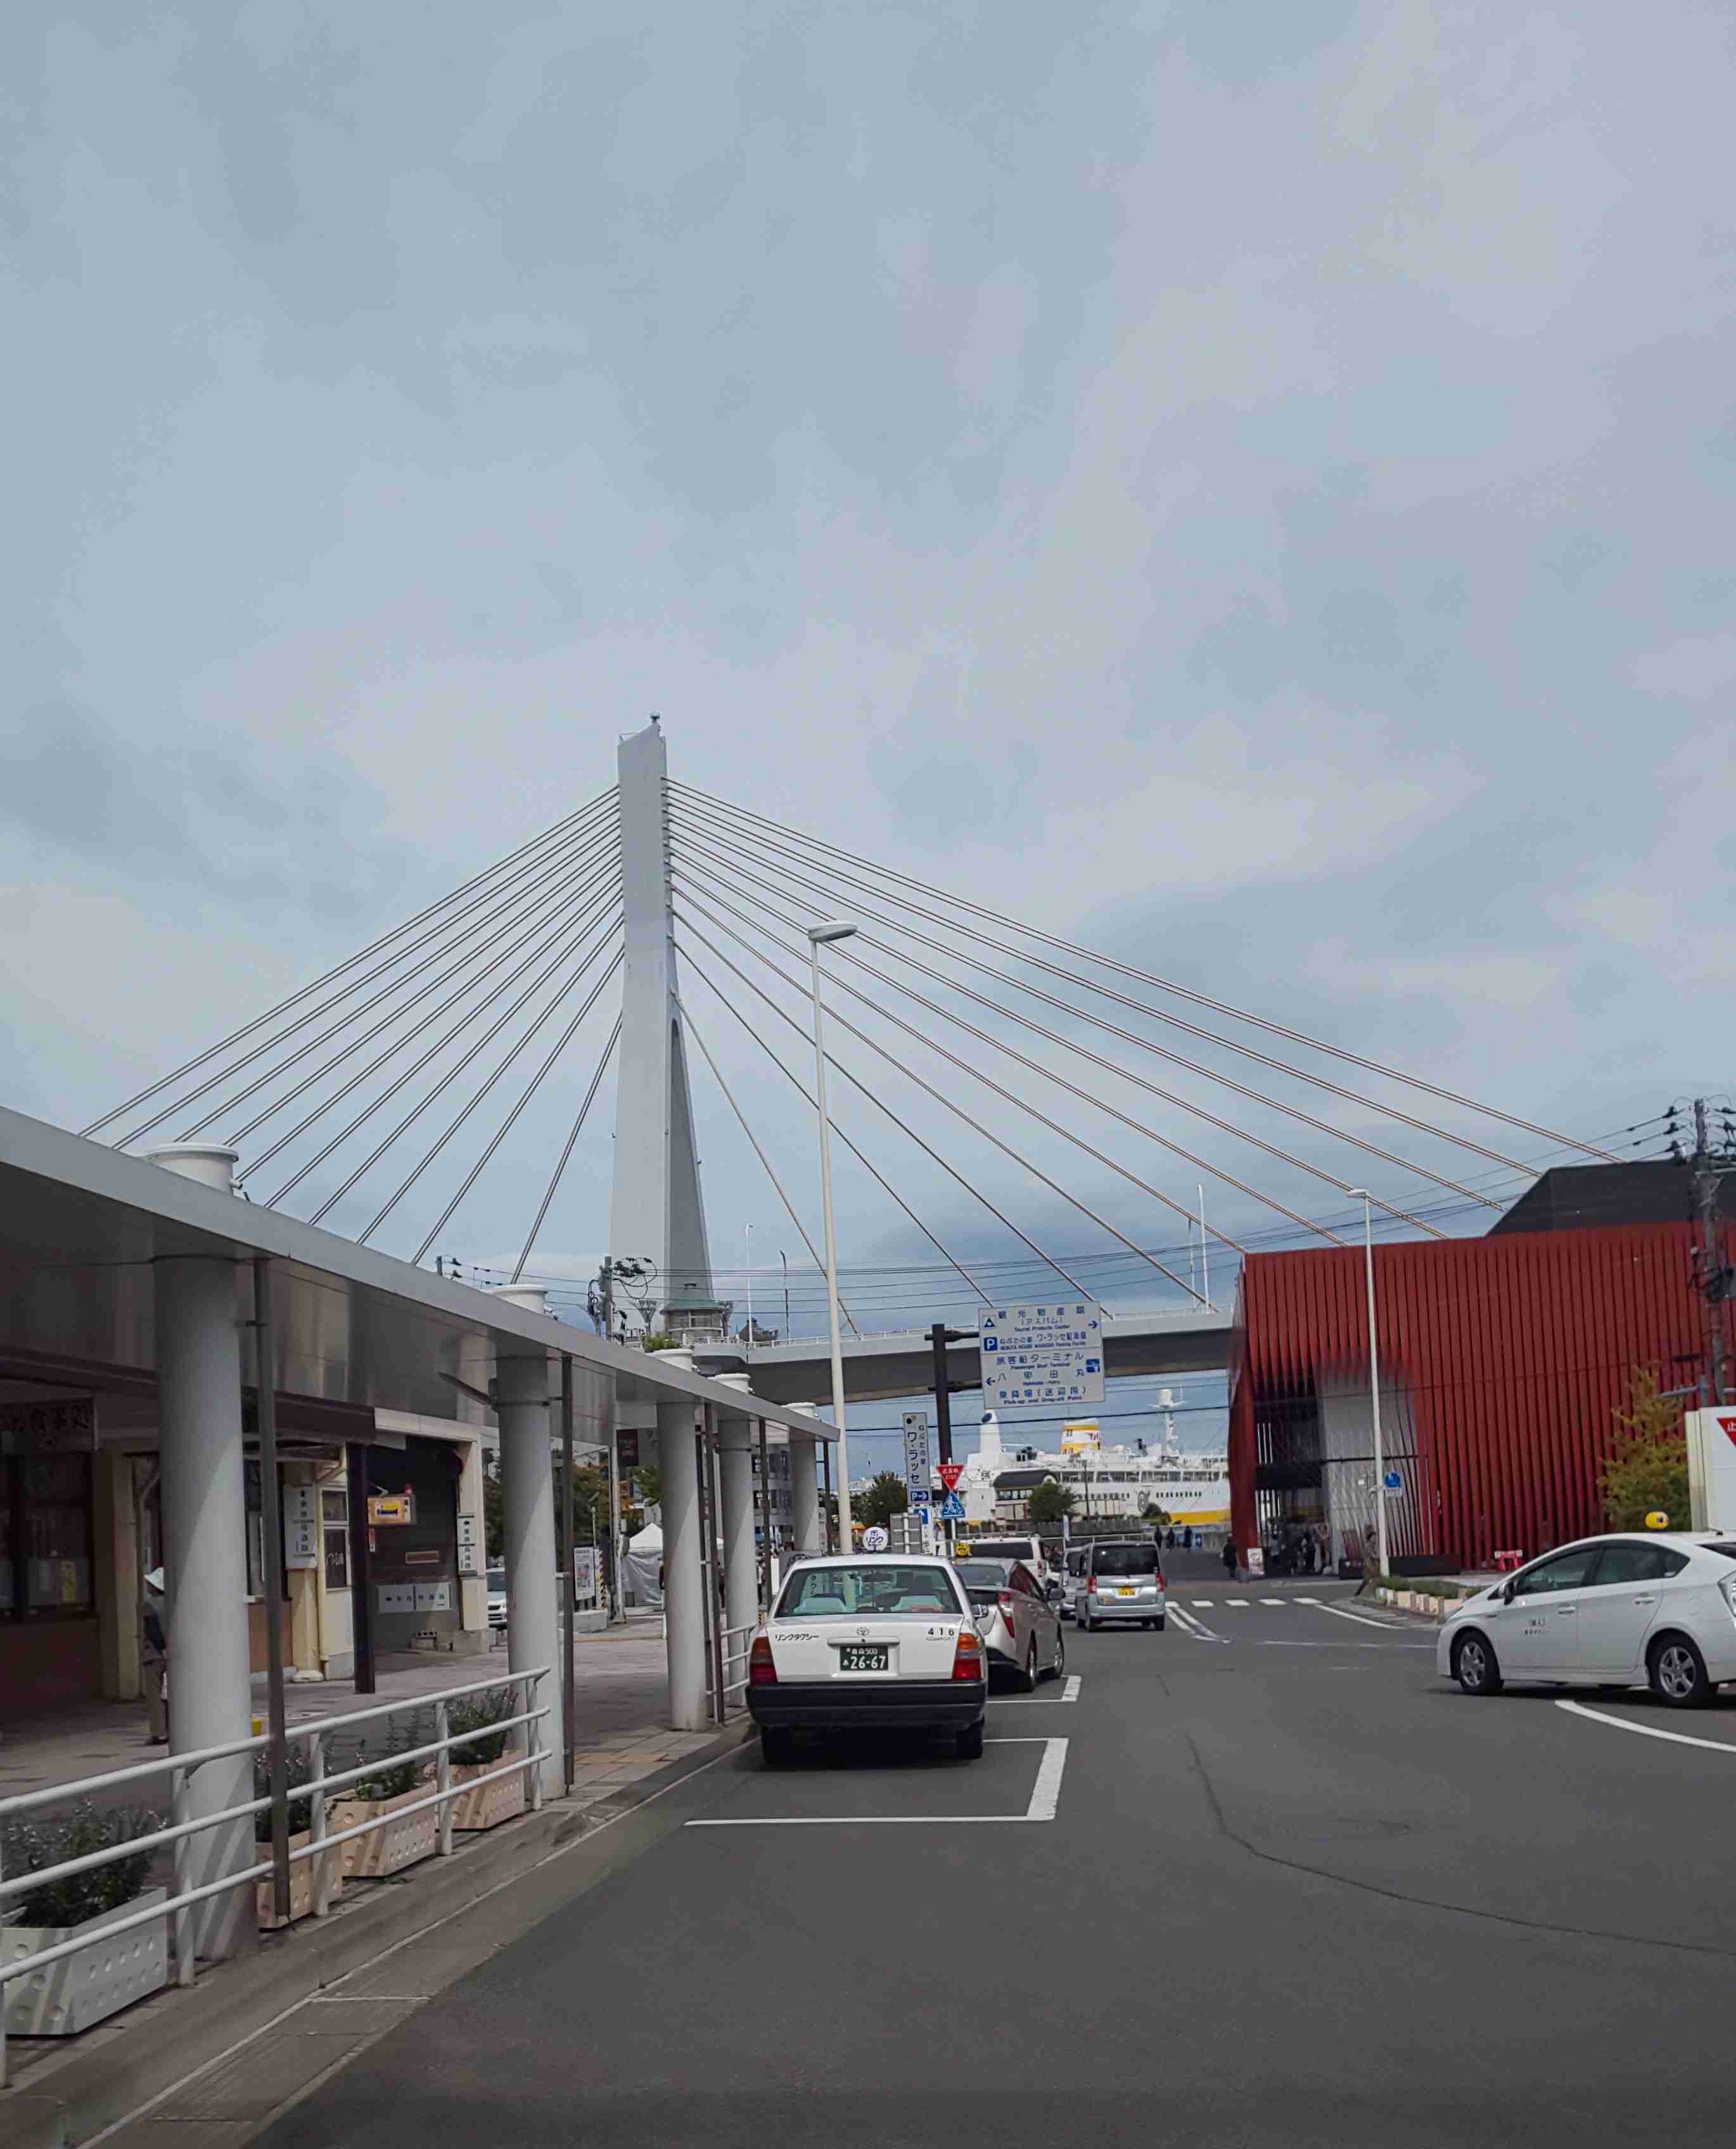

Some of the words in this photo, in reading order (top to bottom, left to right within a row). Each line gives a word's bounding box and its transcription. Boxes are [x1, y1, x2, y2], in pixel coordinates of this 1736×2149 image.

[997, 1368, 1085, 1382] 八甲田丸
[907, 1432, 920, 1484] ワ・ラッセ
[912, 1491, 918, 1500] P
[775, 1633, 819, 1642] リンクタクシー
[850, 1655, 886, 1669] 26-67
